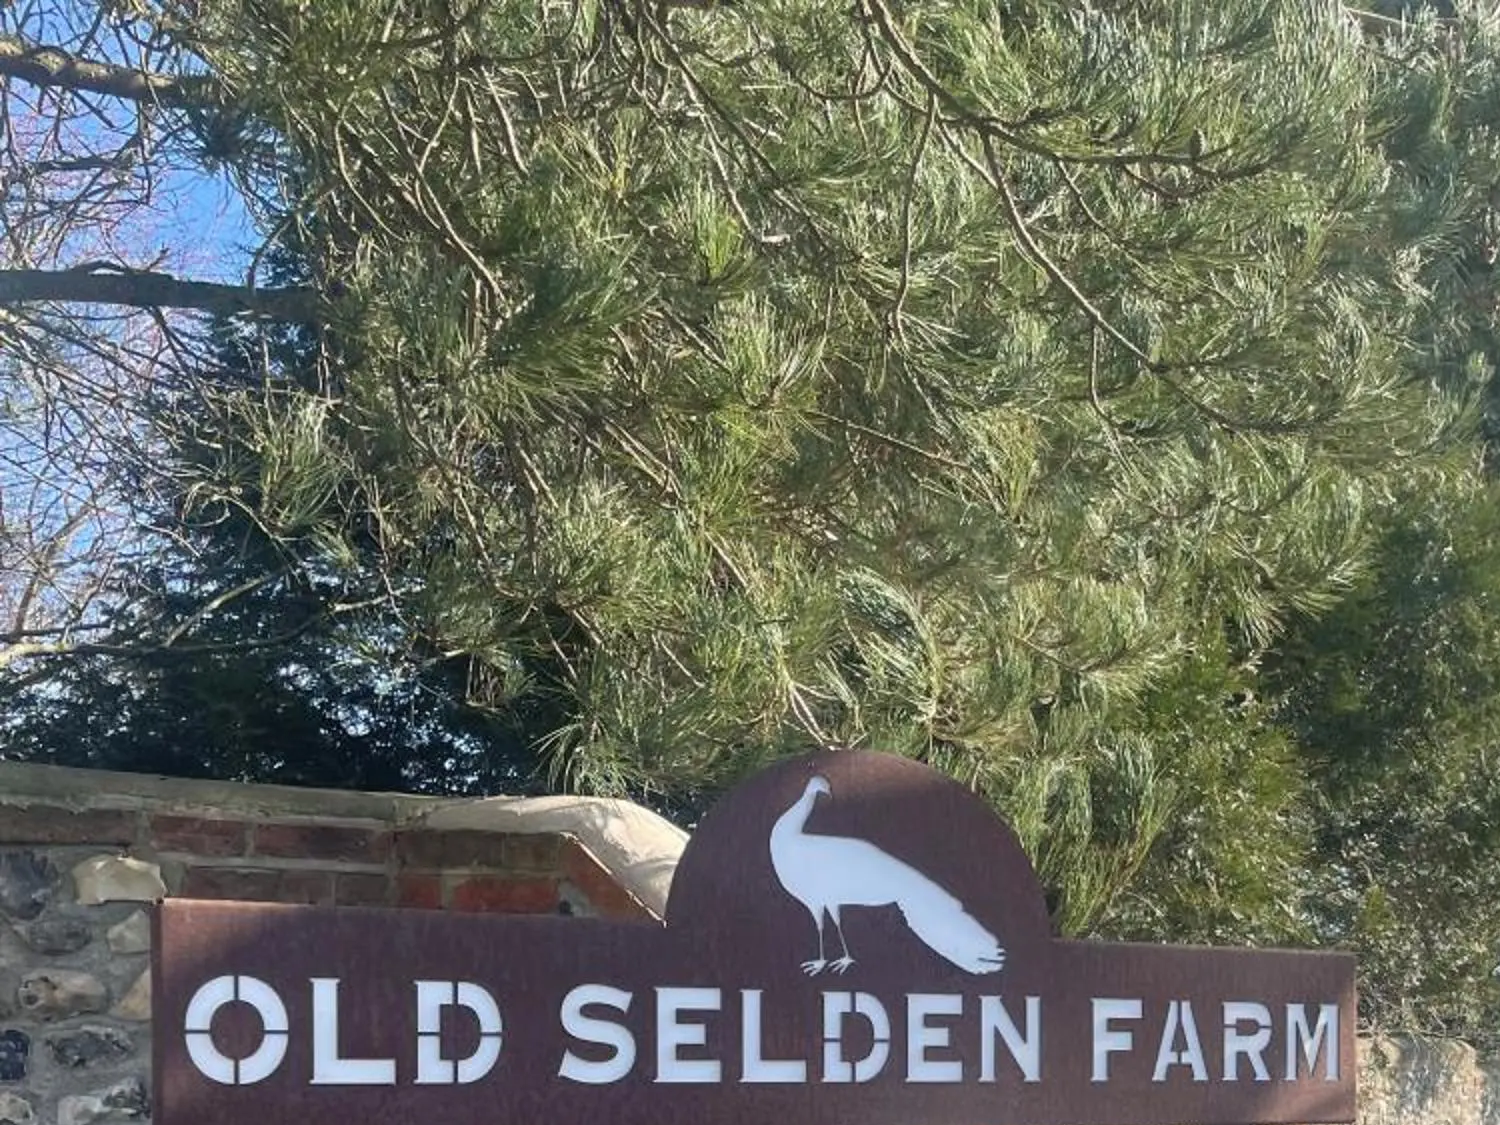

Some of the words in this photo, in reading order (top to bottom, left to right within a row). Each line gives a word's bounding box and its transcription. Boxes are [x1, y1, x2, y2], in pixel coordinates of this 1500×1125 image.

[184, 974, 503, 1086] OLD
[558, 985, 1043, 1086] SELDEN
[1091, 999, 1340, 1084] FARM
